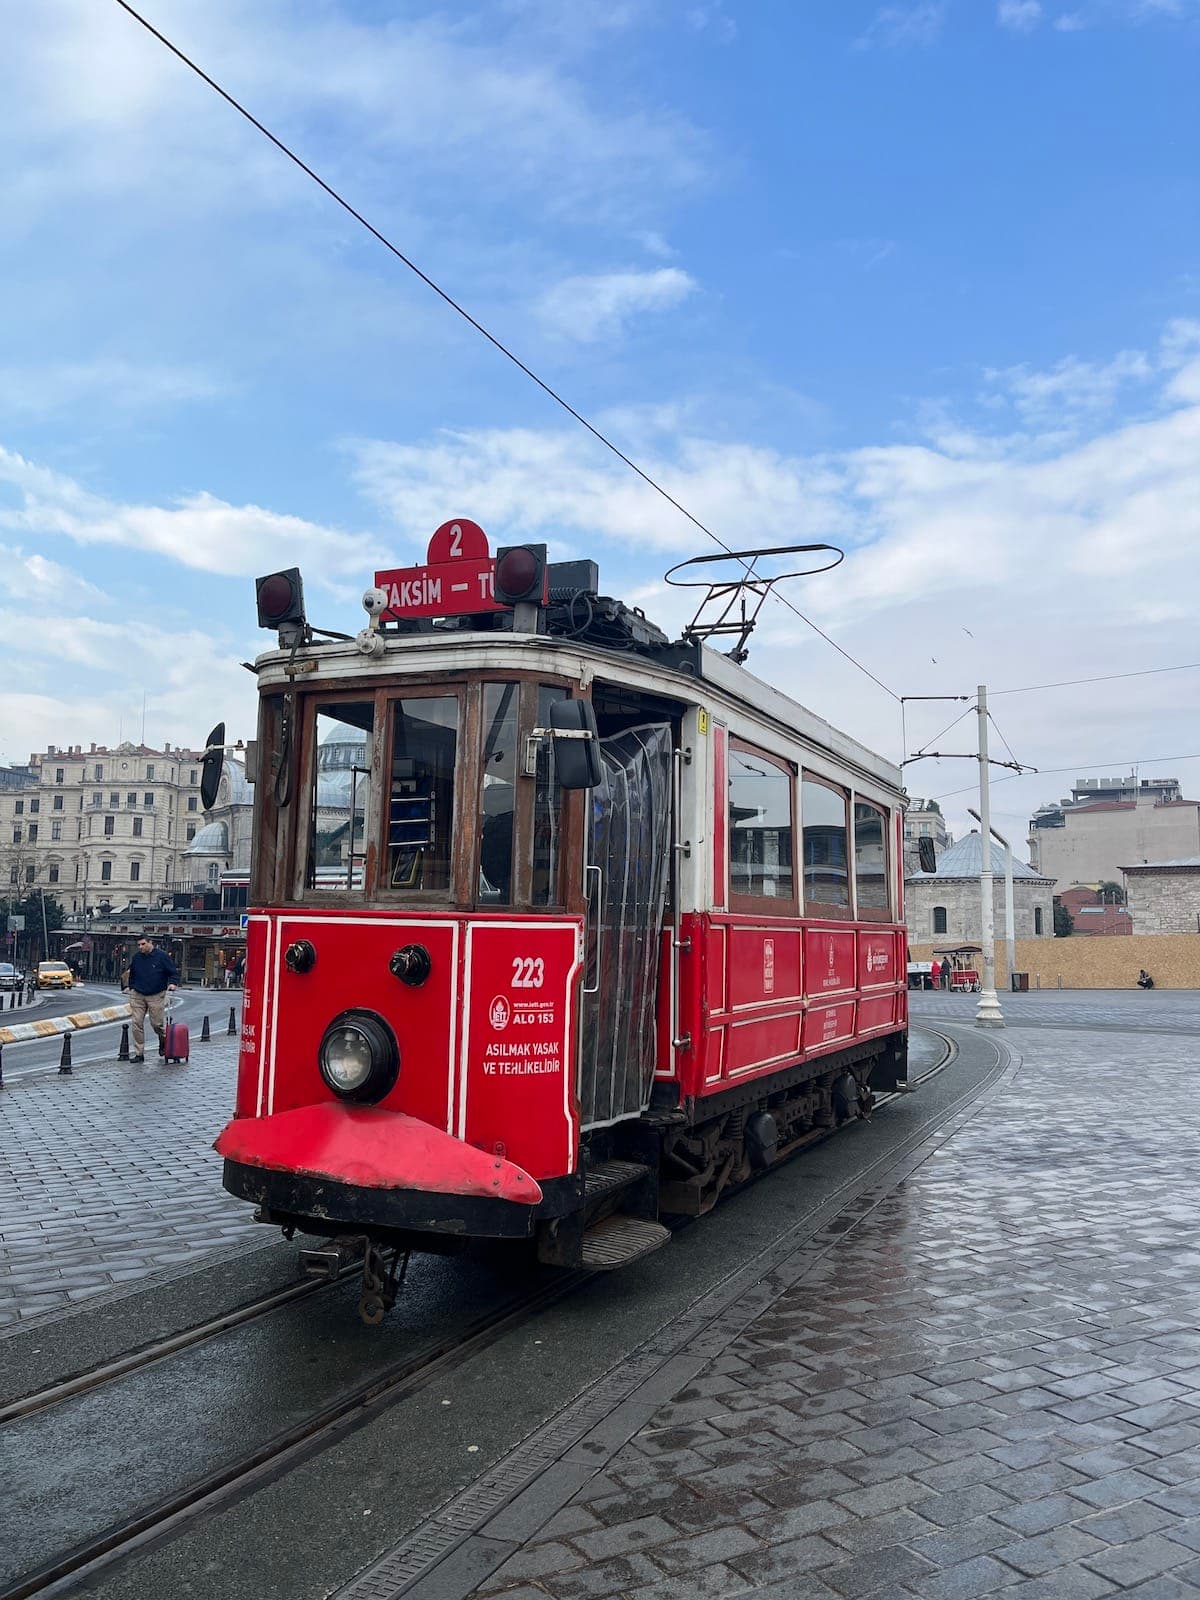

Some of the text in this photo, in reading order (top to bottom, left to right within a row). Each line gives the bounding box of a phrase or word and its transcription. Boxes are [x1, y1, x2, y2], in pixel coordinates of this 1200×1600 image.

[449, 523, 463, 557] 2
[511, 957, 544, 988] 223
[513, 1013, 554, 1025] ALO 153
[486, 1041, 560, 1057] ASILMAK YASAK
[482, 1058, 560, 1075] VE TEHLİKELİDİR
